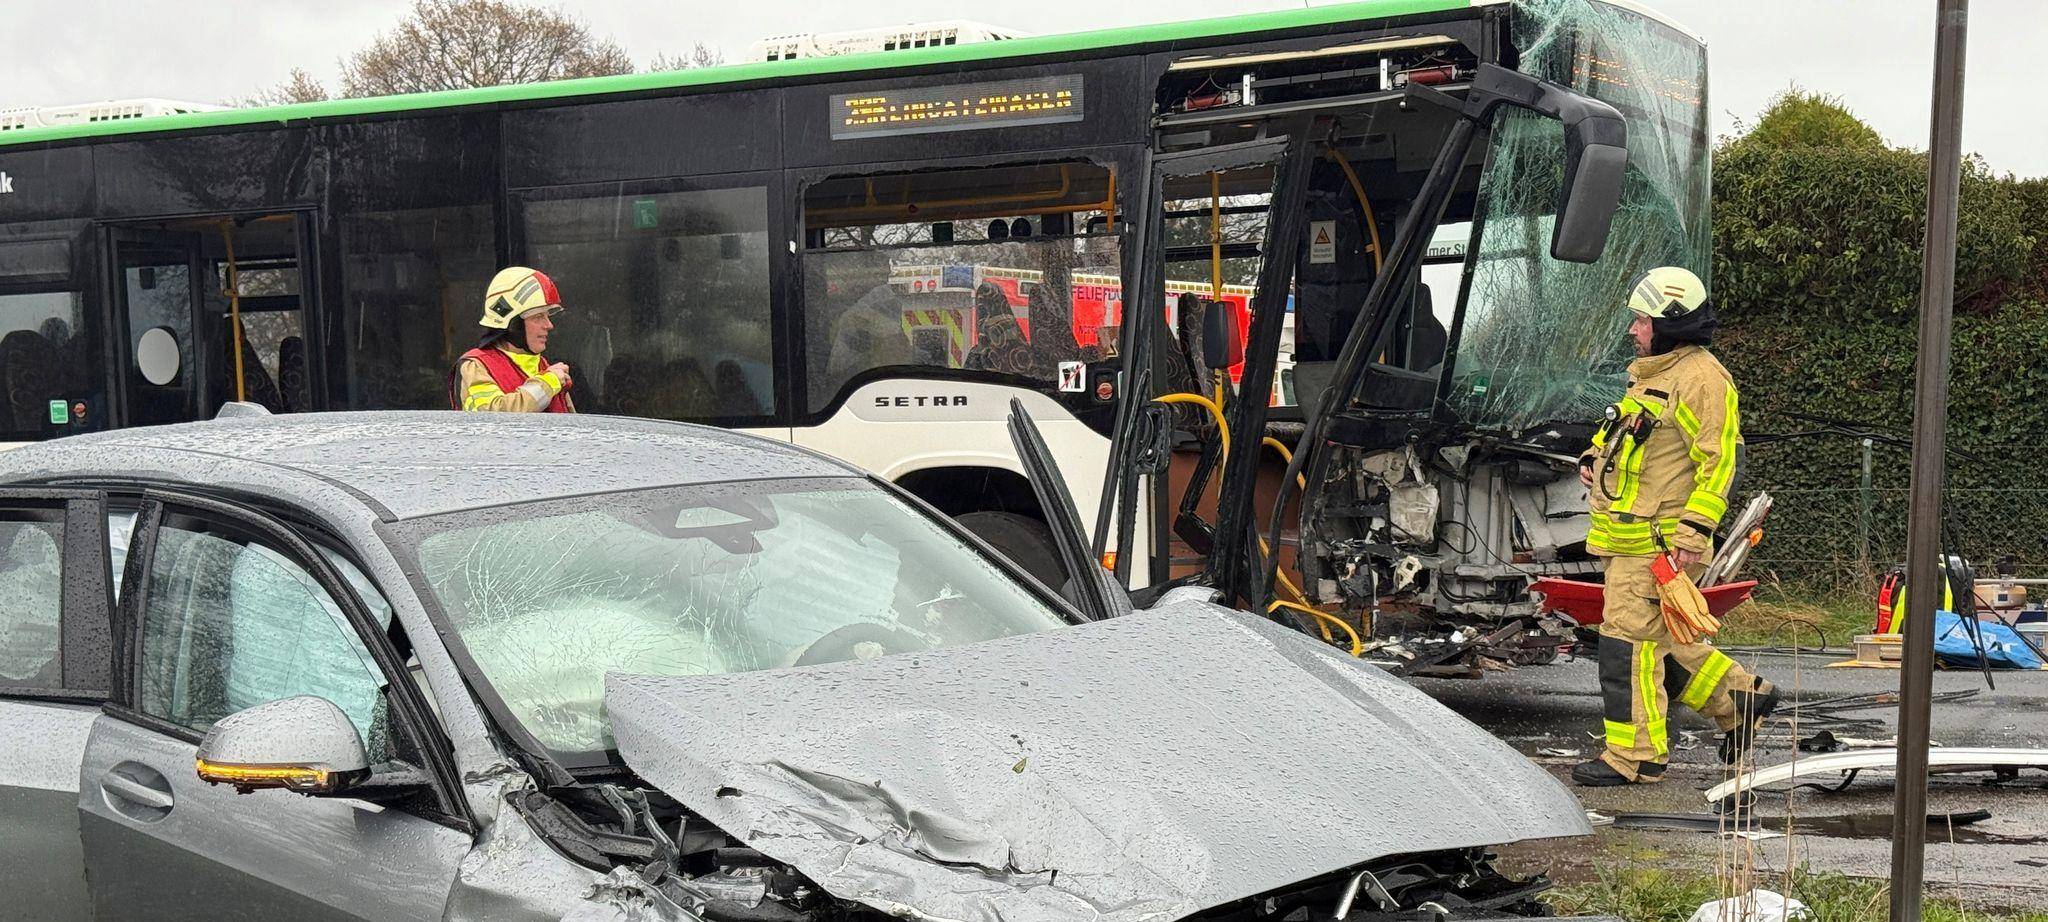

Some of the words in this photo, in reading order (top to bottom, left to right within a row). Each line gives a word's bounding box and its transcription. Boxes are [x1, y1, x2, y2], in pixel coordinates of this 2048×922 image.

[1429, 246, 1451, 256] mer
[1454, 243, 1466, 255] St
[875, 396, 967, 407] SETRA
